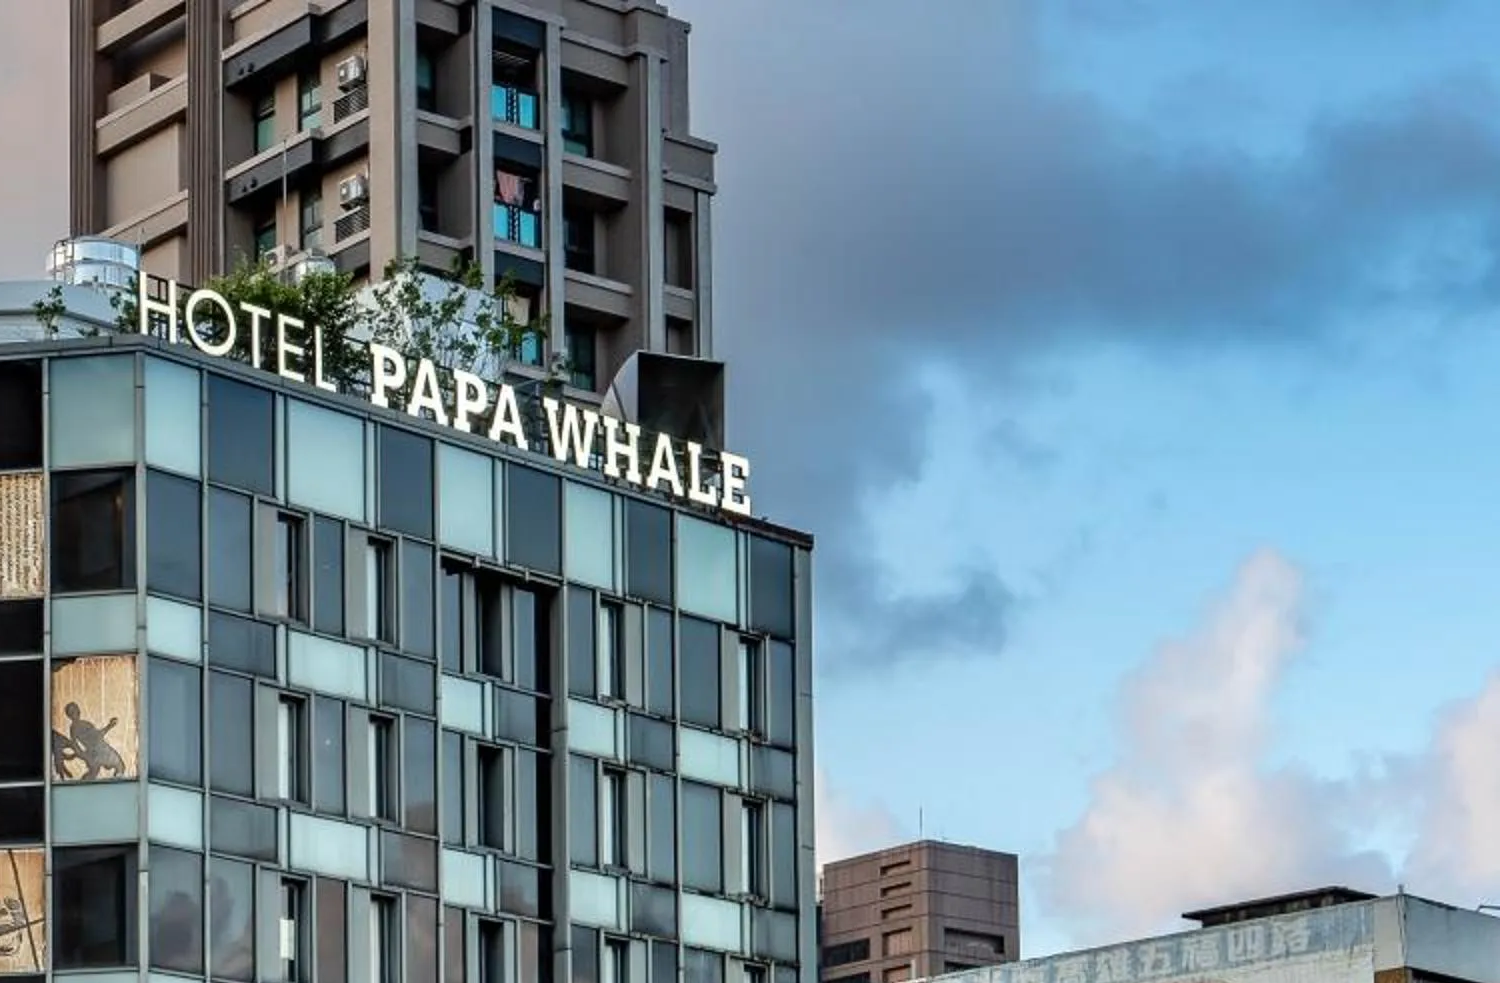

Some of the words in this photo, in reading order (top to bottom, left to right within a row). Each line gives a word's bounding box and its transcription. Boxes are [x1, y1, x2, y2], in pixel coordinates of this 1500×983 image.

[140, 271, 337, 394] HOTEL
[369, 343, 529, 451] PAPA
[543, 397, 752, 516] WHALE
